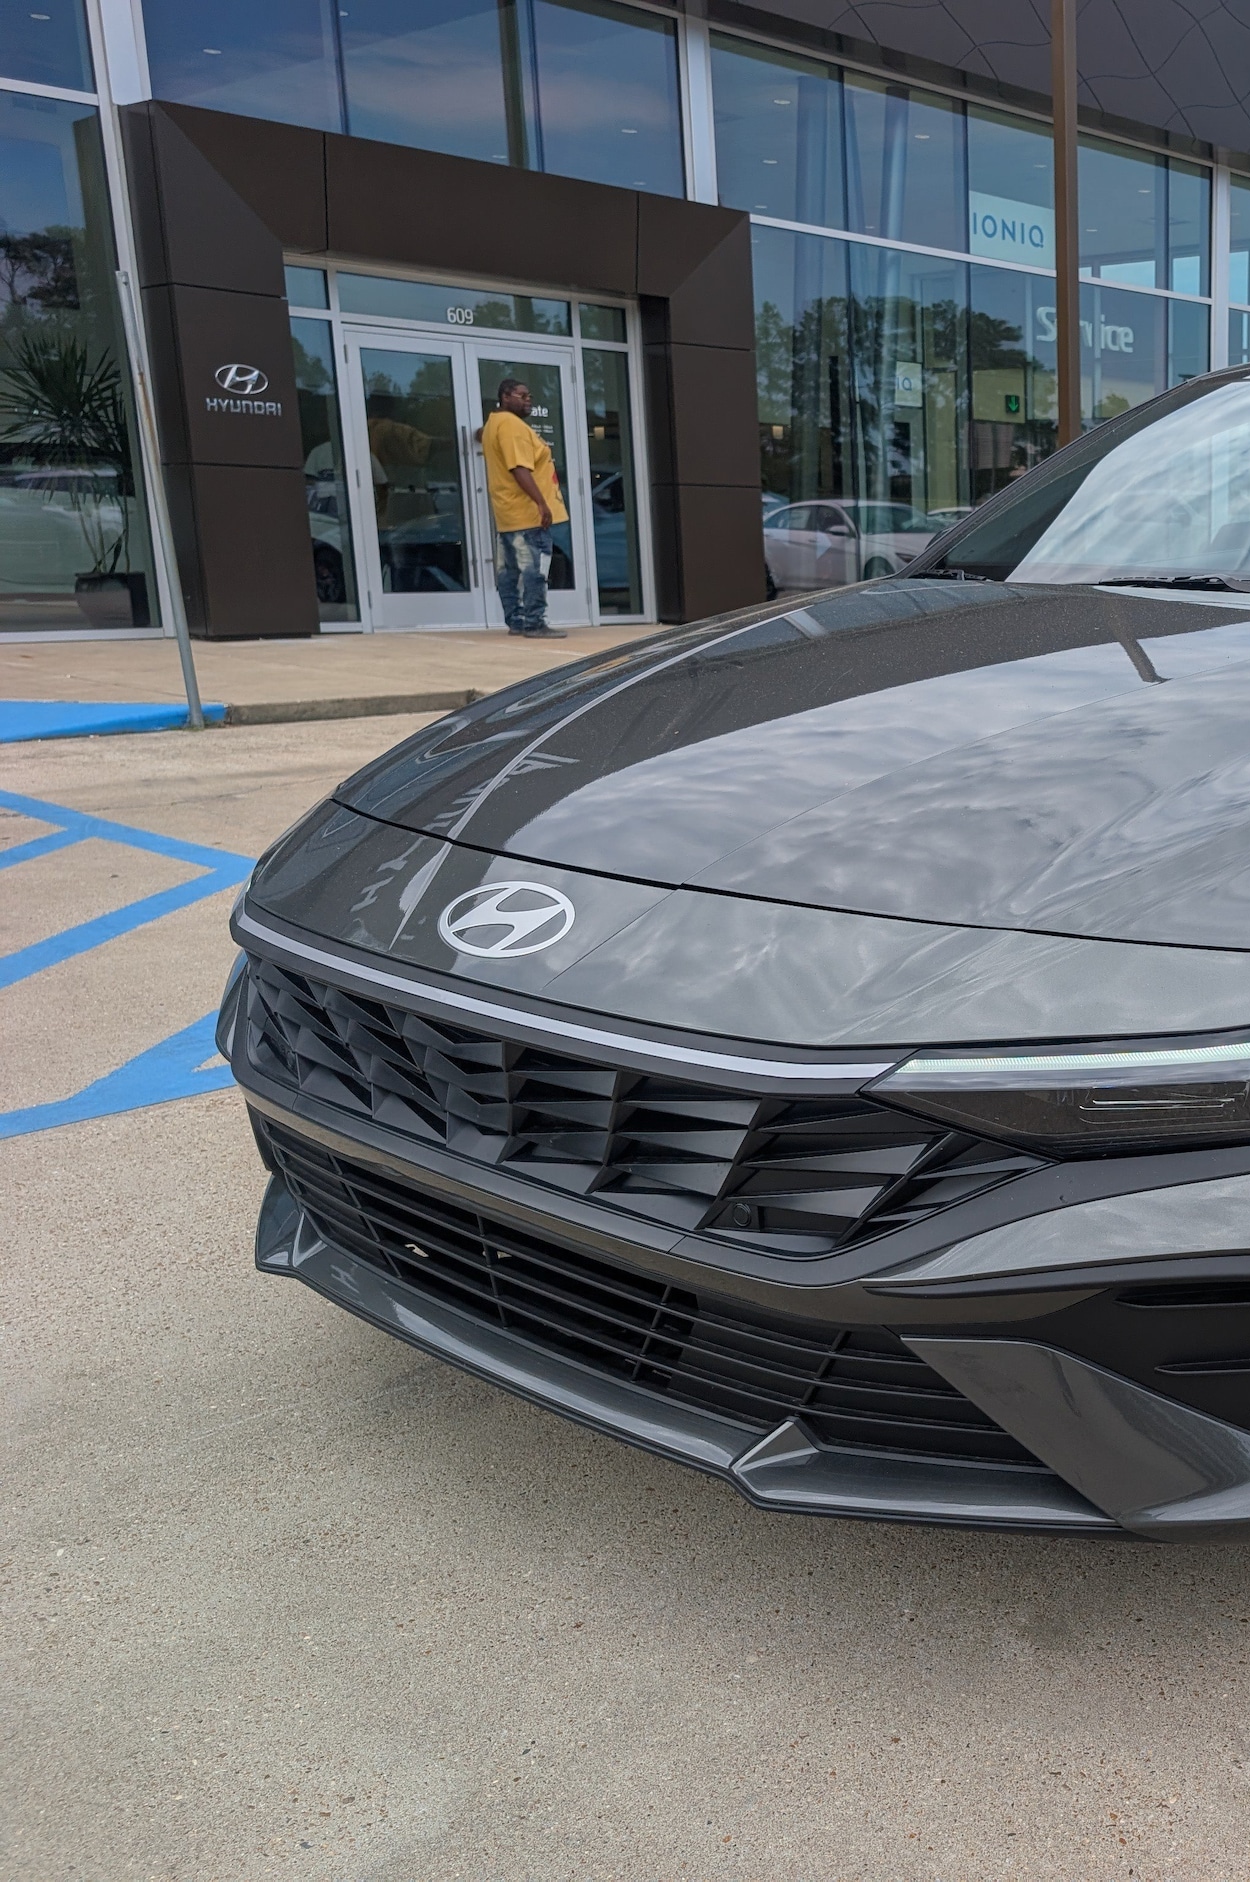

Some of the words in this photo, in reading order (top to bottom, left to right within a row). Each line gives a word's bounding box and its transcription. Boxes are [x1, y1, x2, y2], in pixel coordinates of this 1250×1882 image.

[973, 212, 1045, 249] IONIQ
[446, 307, 474, 325] 609
[1036, 306, 1135, 353] Svice
[206, 397, 282, 417] HYUNDAI
